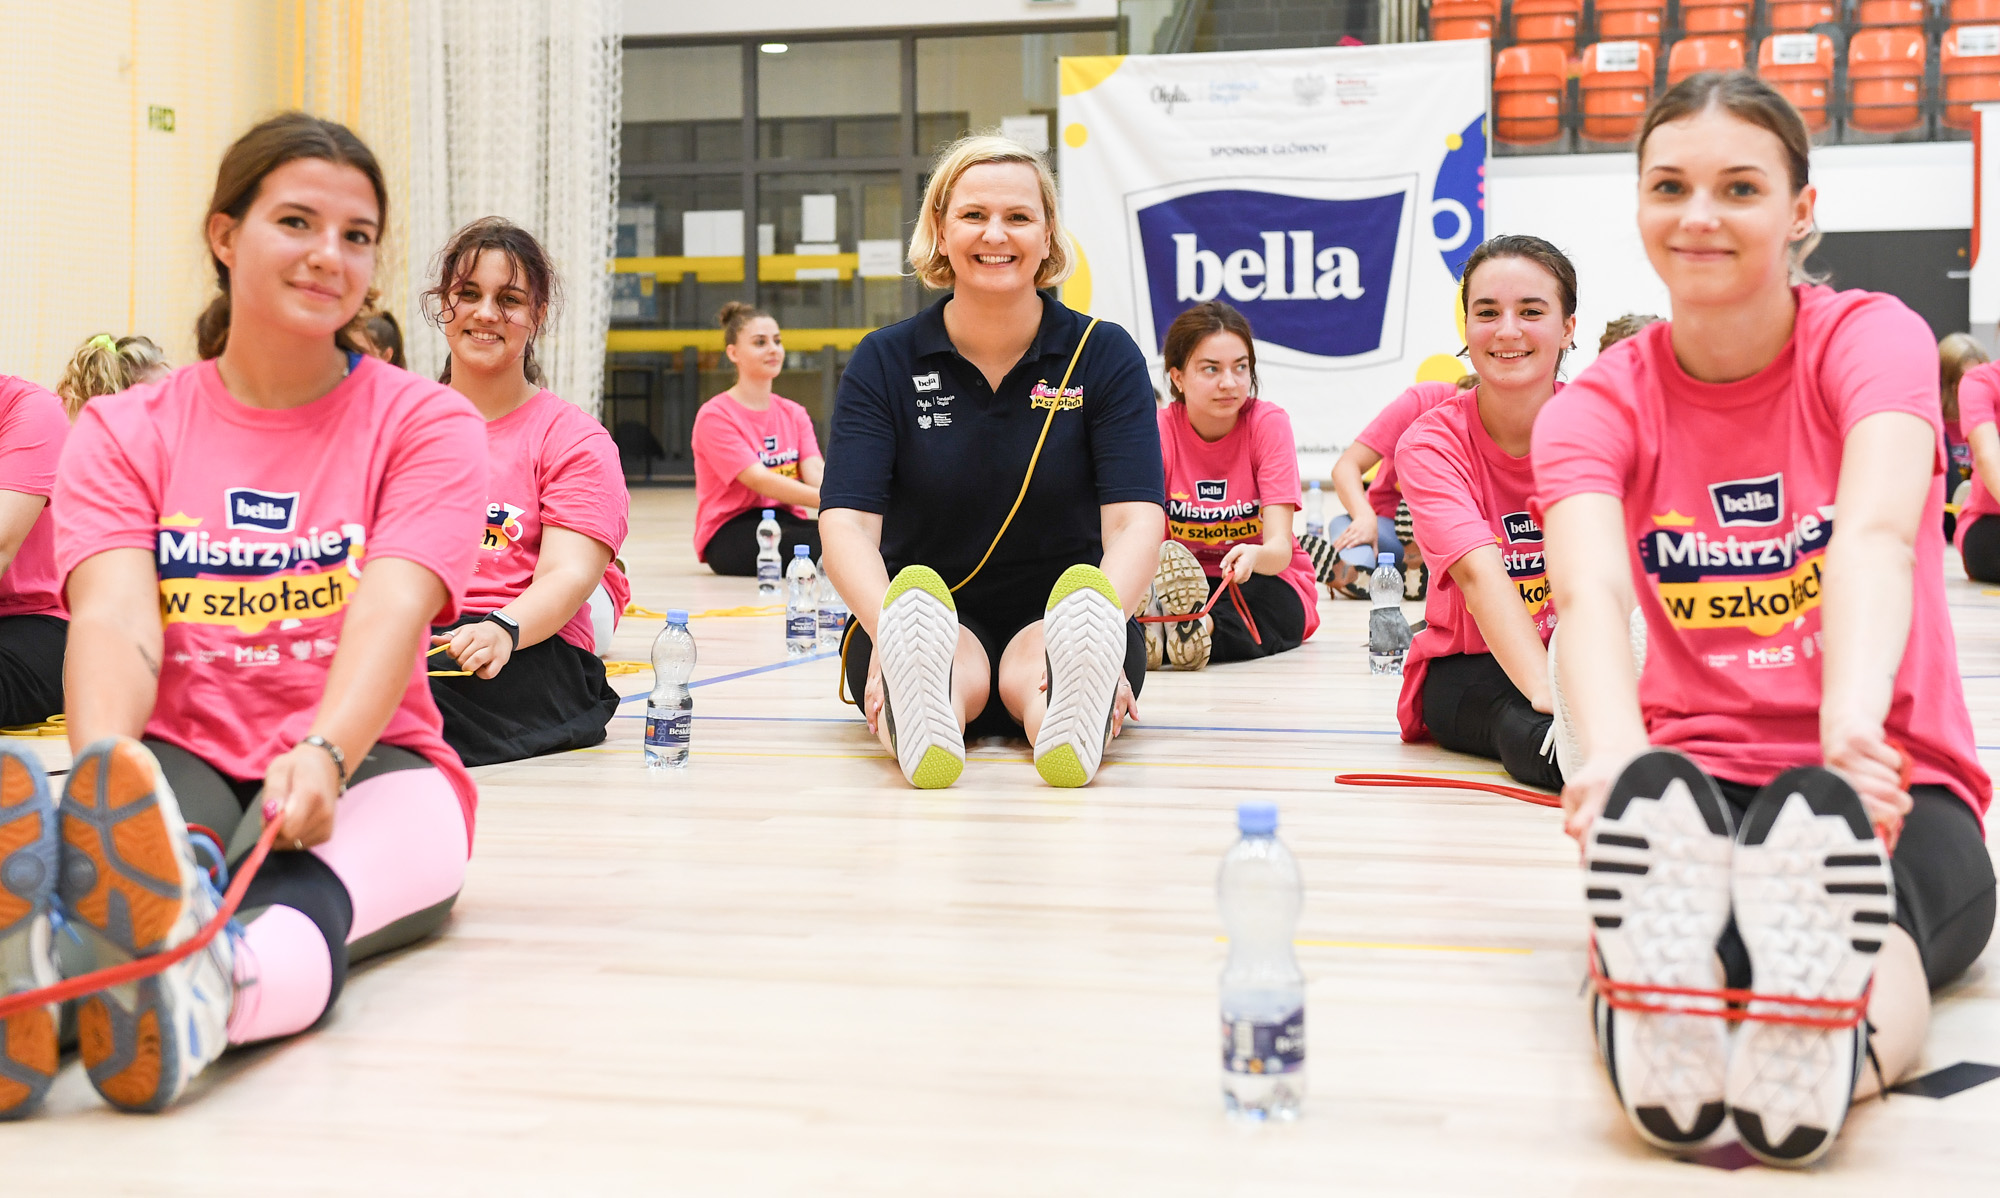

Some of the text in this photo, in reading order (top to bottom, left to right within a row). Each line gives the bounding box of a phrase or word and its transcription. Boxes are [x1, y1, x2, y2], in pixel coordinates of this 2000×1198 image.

[1211, 145, 1268, 157] SPONSOR
[1172, 230, 1364, 303] bella
[1045, 398, 1081, 407] szołach
[1200, 485, 1222, 495] bella
[236, 498, 286, 520] bella
[1169, 499, 1254, 520] Mistrzynie
[1722, 491, 1775, 513] bella
[1171, 522, 1257, 539] w szkołach
[166, 576, 343, 616] w szkołach
[1666, 597, 1695, 620] w
[1748, 645, 1795, 664] MwS
